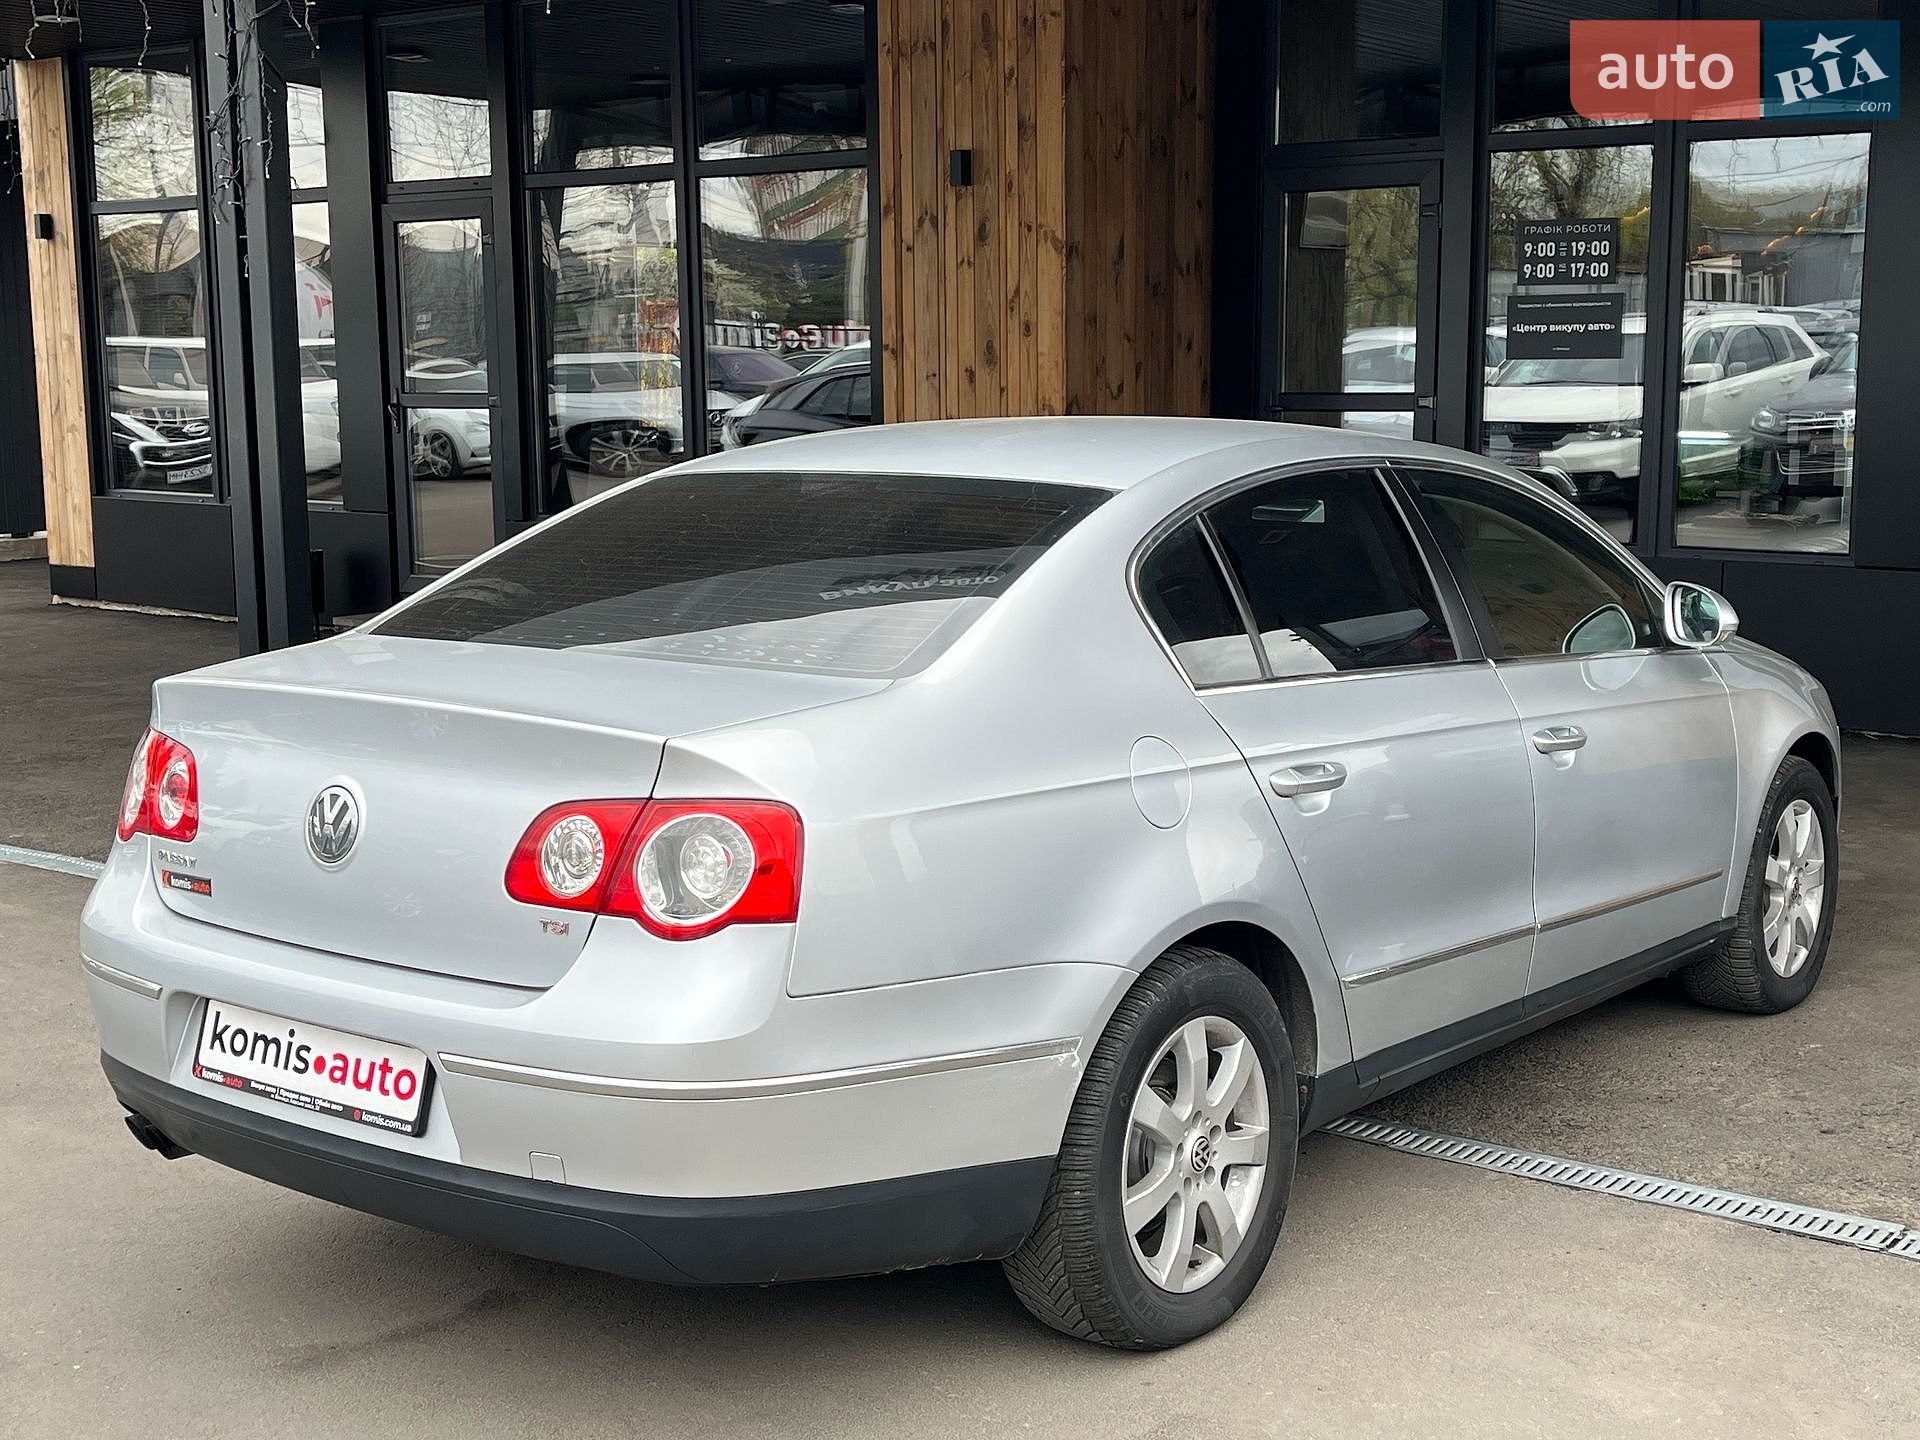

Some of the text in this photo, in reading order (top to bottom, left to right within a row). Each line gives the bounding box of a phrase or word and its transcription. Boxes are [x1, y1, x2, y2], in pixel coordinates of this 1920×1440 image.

[1525, 224, 1611, 235] ГРАФІК РОБОТИ
[1523, 240, 1610, 258] 9:00 19:00
[1523, 262, 1609, 279] 9:00 17:00
[1549, 323, 1586, 333] викупу
[539, 918, 570, 935] TSI
